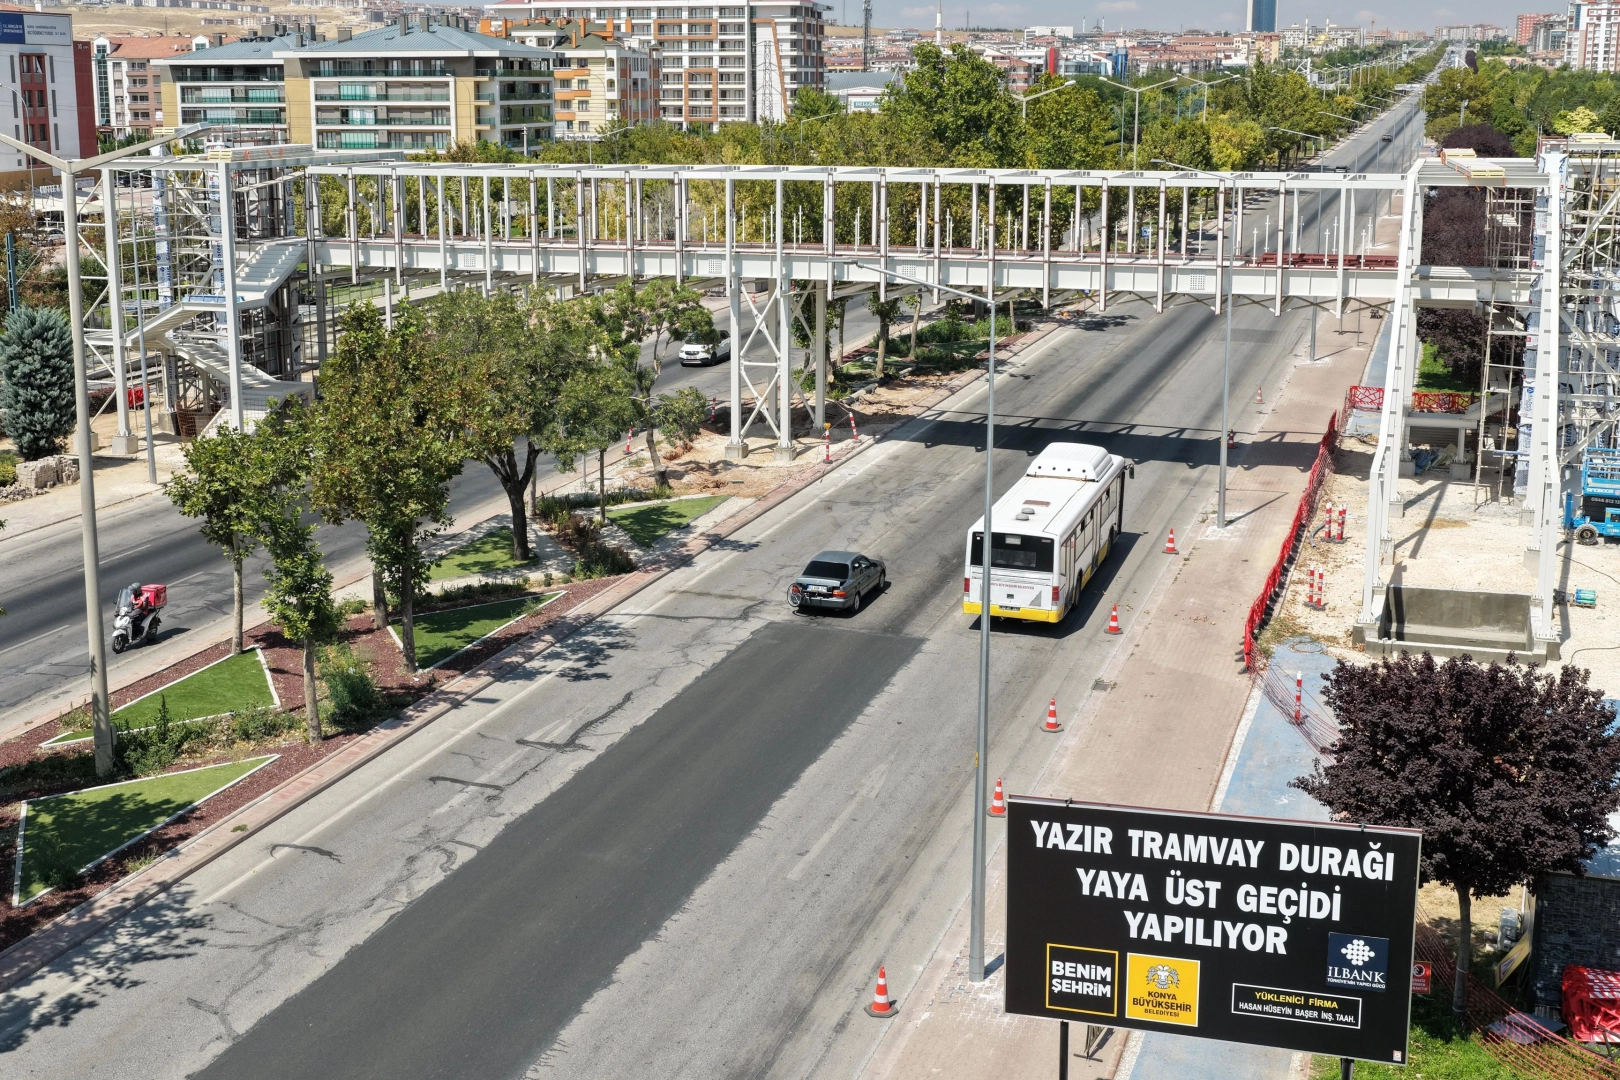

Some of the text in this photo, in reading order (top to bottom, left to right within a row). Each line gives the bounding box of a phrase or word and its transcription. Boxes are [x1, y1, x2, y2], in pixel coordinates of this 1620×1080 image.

[1030, 820, 1395, 881] YAZIR TRAMVAY DURAĞI
[1076, 868, 1341, 924] YAYA ÜST GEÇİDİ
[1123, 910, 1288, 955] YAPILIYOR
[1051, 960, 1112, 982] BENİM
[1051, 978, 1111, 998] ŞEHRİM
[1147, 990, 1177, 1001] KONYA
[1132, 997, 1192, 1013] BÜYÜKŞEHİR
[1255, 991, 1339, 1009] YÜKLENİCİ FİRMA
[1144, 1008, 1180, 1018] BELEDİYESİ
[1239, 1001, 1356, 1023] HASAN HÜSEYİN BAŞER İNŞ. TAAH.
